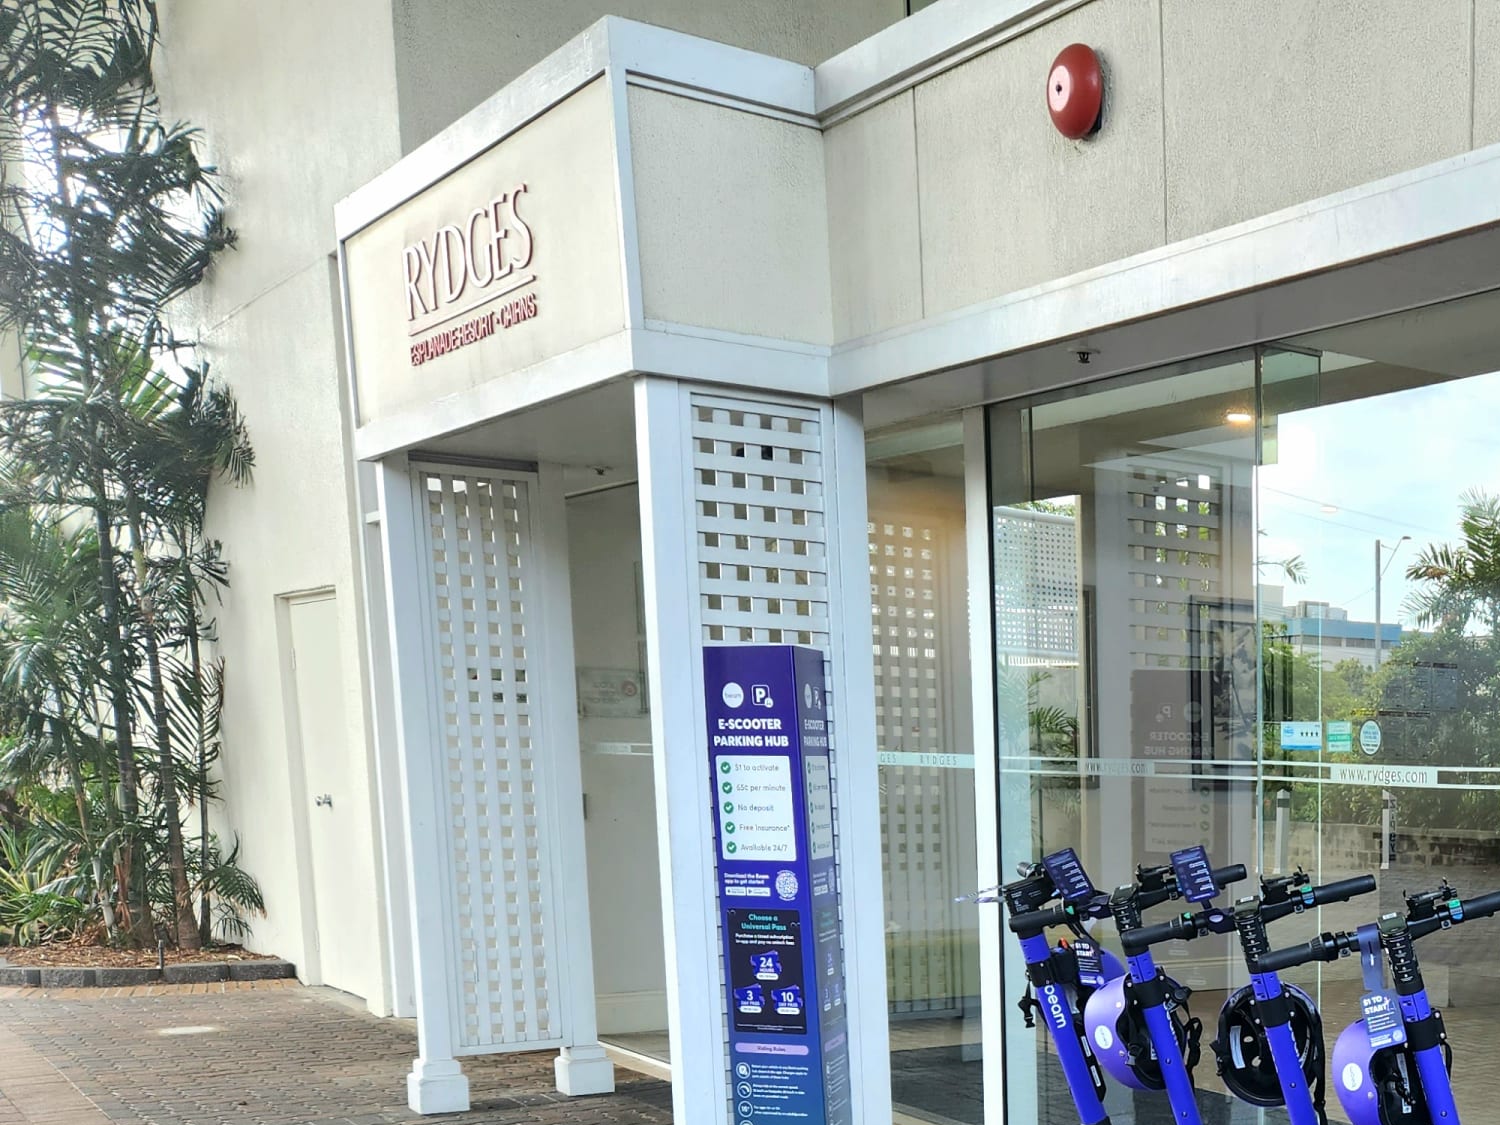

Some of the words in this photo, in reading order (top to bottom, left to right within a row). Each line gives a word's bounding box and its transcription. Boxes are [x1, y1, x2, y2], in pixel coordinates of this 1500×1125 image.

[402, 182, 534, 322] RYDGES
[458, 311, 495, 349] RESORT
[500, 293, 537, 329] CAIRNS
[718, 718, 782, 730] E-SCOOTER
[713, 735, 763, 747] PARKING
[764, 735, 790, 747] HUB
[1339, 767, 1428, 785] www.rydges.com
[748, 913, 772, 921] Choose
[759, 957, 774, 968] 24
[746, 990, 754, 1001] 3
[781, 991, 794, 1002] 10
